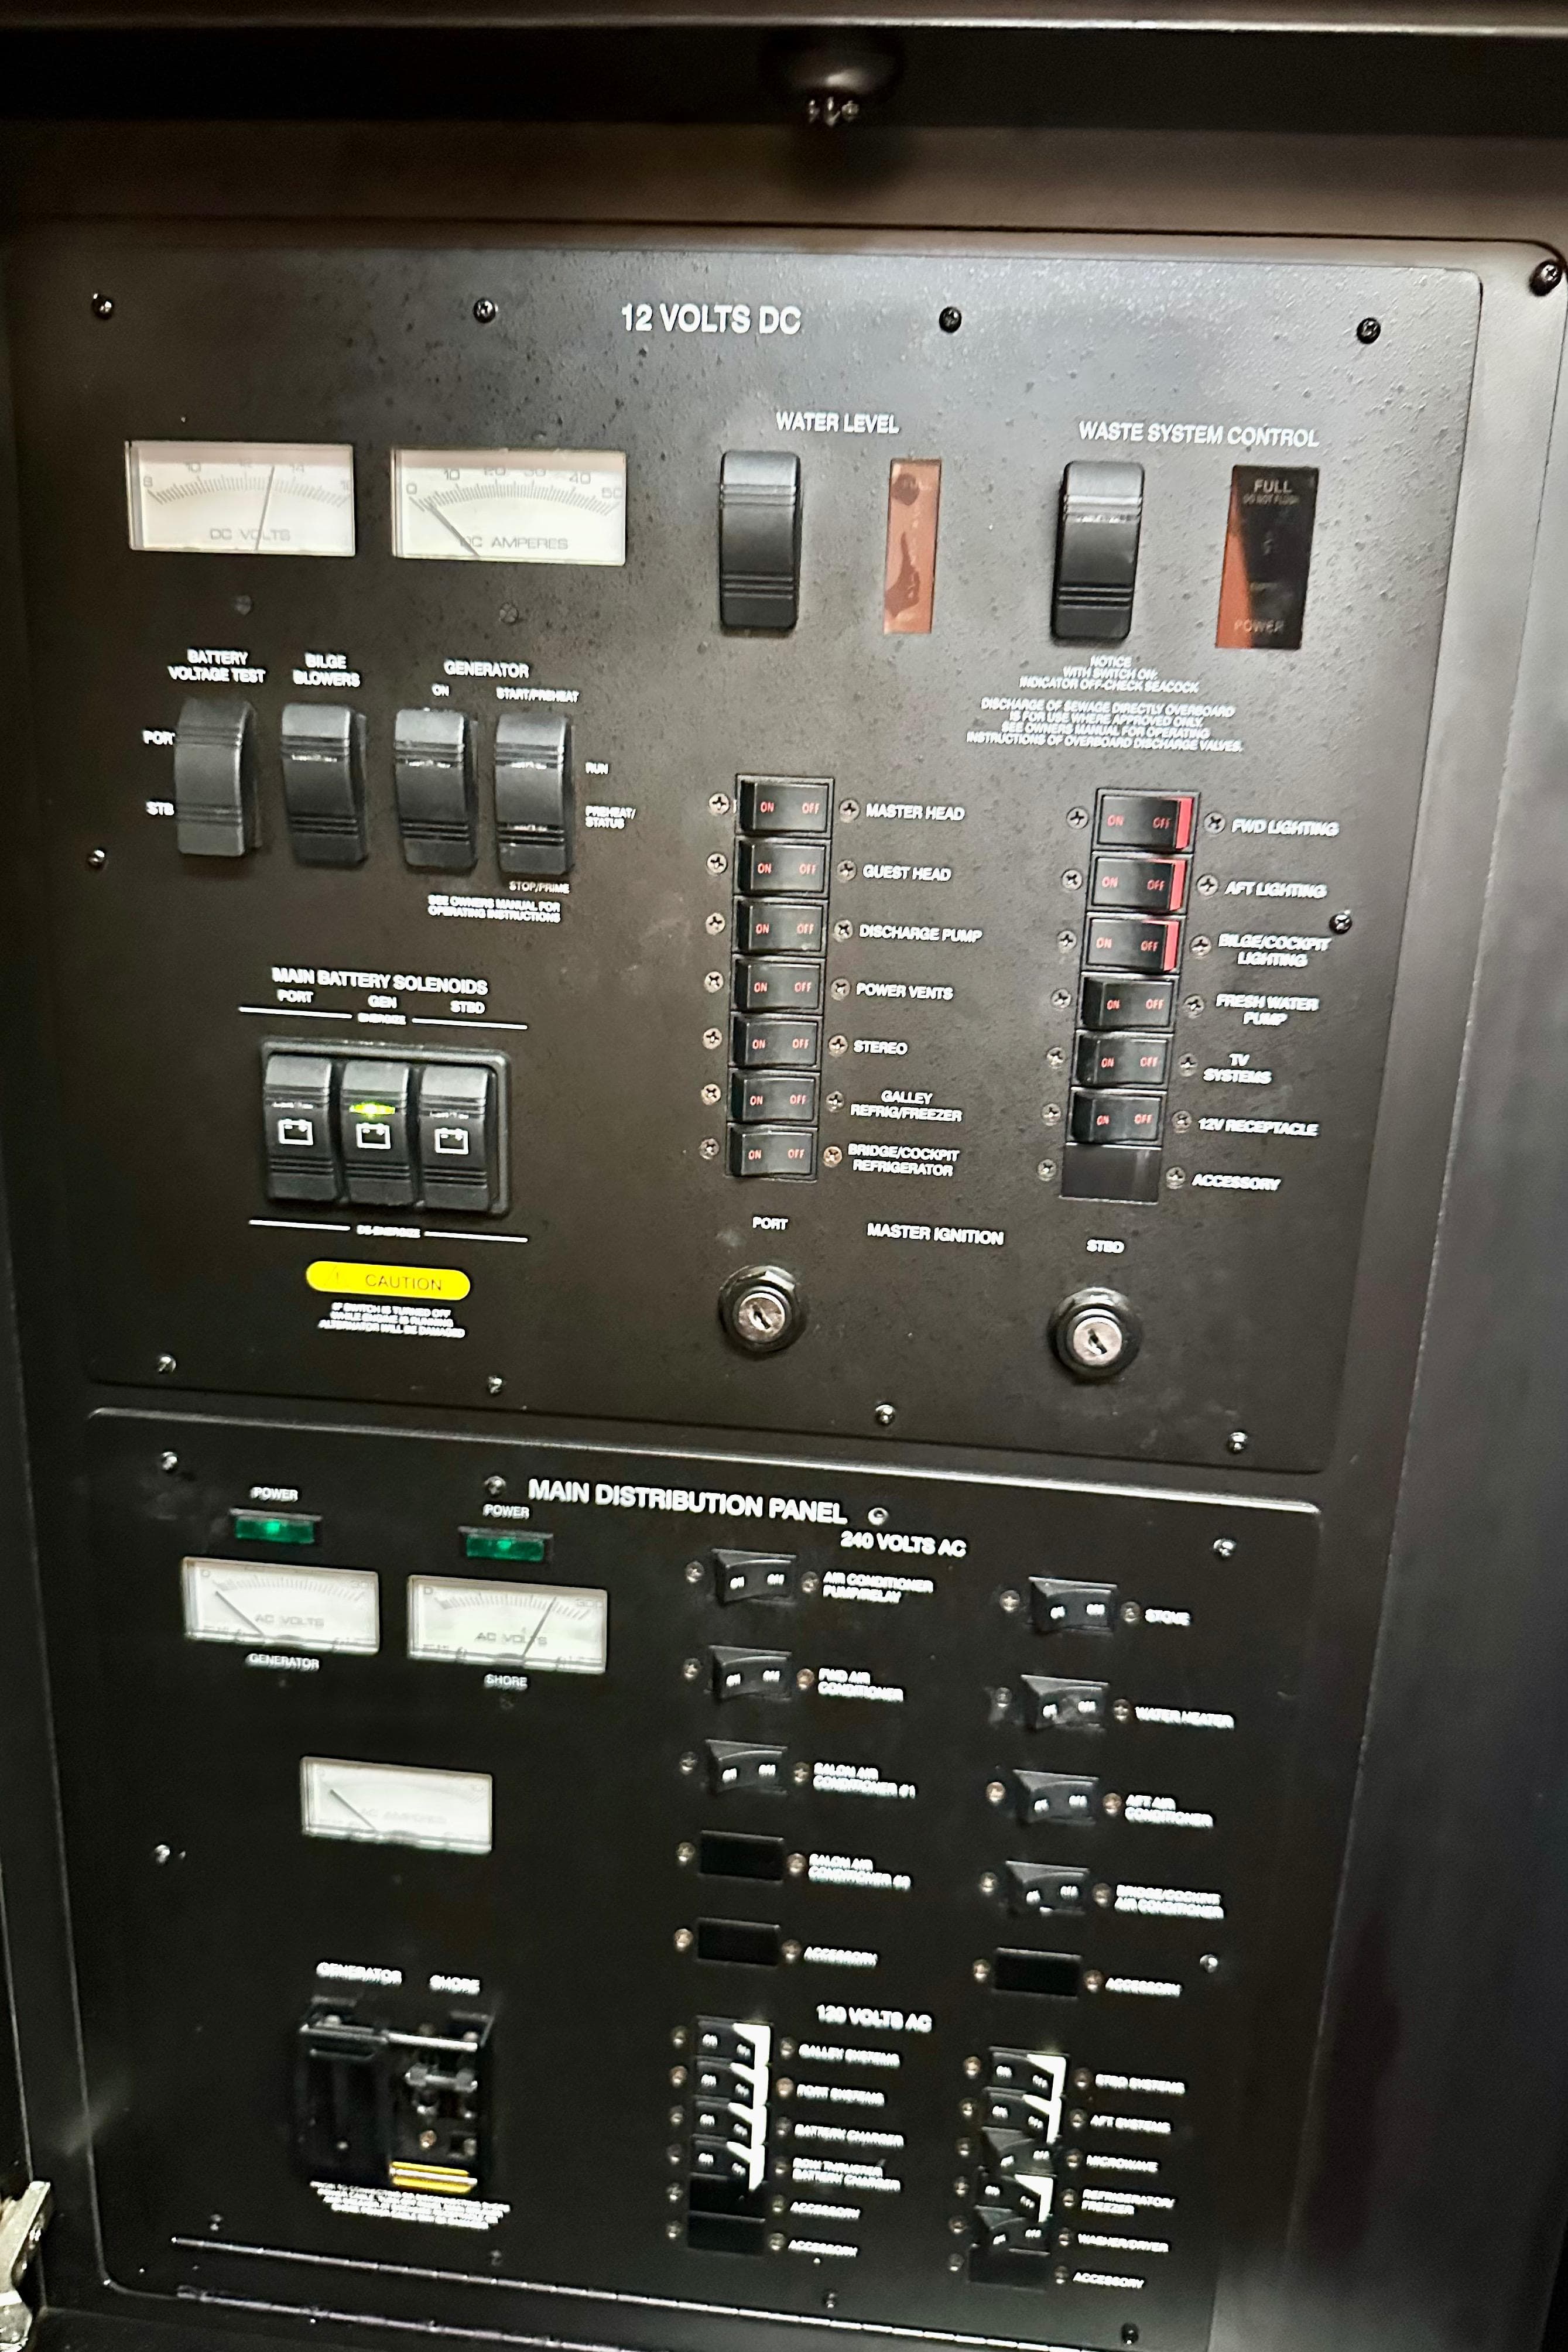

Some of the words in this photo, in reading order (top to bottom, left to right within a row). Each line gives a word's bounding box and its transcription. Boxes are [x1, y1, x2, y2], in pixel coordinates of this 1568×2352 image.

[621, 303, 653, 331] 12
[660, 304, 751, 333] VOLTS
[759, 306, 800, 334] DC
[776, 411, 838, 432] WATER
[844, 413, 900, 434] LEVEL
[1079, 421, 1144, 441] WASTE
[1147, 423, 1222, 445] SYSTEM
[1227, 426, 1320, 448] CONTROL
[1254, 479, 1293, 494] FULL
[210, 529, 232, 540] DC
[240, 530, 290, 540] VOLTS
[492, 537, 569, 549] AMPERES
[1234, 619, 1284, 634] POWER
[187, 649, 248, 665] BATTERY
[305, 653, 346, 669] BILGE
[1090, 655, 1132, 667] NOTICE
[168, 666, 230, 682] VOLTAGE
[232, 668, 265, 683] TEST
[444, 660, 529, 679] GENERATOR
[1063, 666, 1091, 678] WITH
[1093, 668, 1135, 679] SWITCH
[293, 670, 360, 687] BLOWERS
[1019, 676, 1077, 689] INDICATOR
[432, 684, 450, 697] ON
[496, 687, 579, 703] START/PREHEAT
[981, 698, 1045, 711] DISCHARGE
[1046, 700, 1062, 711] OF
[1063, 701, 1111, 713] SEWAGE
[1112, 703, 1163, 715] DIRECTLY
[1165, 706, 1235, 717] OVERBOARD
[1009, 711, 1021, 721] IS
[1022, 711, 1045, 723] FOR
[1046, 713, 1070, 724] USE
[1071, 714, 1111, 725] WHERE
[1112, 714, 1171, 727] APPROVED
[1001, 722, 1023, 733] SEE
[1074, 725, 1119, 737] MANUAL
[1121, 727, 1144, 737] FOR
[1146, 727, 1210, 739] OPERATING
[966, 731, 1045, 745] INSTRUCTIONS
[1047, 735, 1062, 746] OF
[1064, 736, 1131, 748] OVERBOARD
[1133, 738, 1198, 751] DISCHARGE
[586, 762, 608, 775] RUN
[761, 802, 774, 813] ON
[802, 803, 819, 814] OFF
[866, 804, 923, 820] MASTER
[925, 806, 965, 821] HEAD
[586, 817, 625, 829] STATUS
[1107, 815, 1124, 826] ON
[1153, 817, 1171, 829] OFF
[1231, 820, 1266, 834] FWD
[1268, 821, 1340, 837] LIGHTING
[758, 863, 772, 874] ON
[799, 864, 816, 875] OFF
[862, 864, 910, 879] GUEST
[912, 867, 951, 881] HEAD
[509, 881, 570, 894] STOP/PRIME
[1102, 877, 1118, 888] ON
[1147, 879, 1166, 891] OFF
[1224, 881, 1255, 896] AFT
[1256, 882, 1328, 899] LIGHTING
[755, 923, 769, 934] ON
[797, 924, 814, 934] OFF
[860, 924, 939, 941] DISCHARGE
[942, 928, 983, 943] PUMP
[1096, 937, 1112, 949] ON
[1141, 940, 1158, 951] OFF
[1218, 934, 1333, 951] BILGE/COCKPIT
[1238, 951, 1308, 968] LIGHTING
[272, 967, 315, 984] MAIN
[317, 970, 391, 988] BATTERY
[393, 974, 488, 995] SOLENOIDS
[754, 982, 767, 993] ON
[795, 982, 811, 993] OFF
[278, 990, 313, 1004] PORT
[857, 982, 907, 998] POWER
[909, 985, 953, 1000] VENTS
[368, 995, 397, 1009] GEN
[450, 1001, 485, 1014] STBD
[1107, 999, 1120, 1010] ON
[1146, 999, 1165, 1010] OFF
[1216, 994, 1265, 1009] FRESH
[1266, 996, 1319, 1011] WATER
[1243, 1012, 1288, 1026] PUMP
[752, 1039, 765, 1049] ON
[792, 1039, 809, 1049] OFF
[854, 1040, 908, 1055] STEREO
[1101, 1057, 1114, 1068] ON
[1140, 1057, 1158, 1068] OFF
[1229, 1054, 1250, 1066] TV
[1203, 1069, 1272, 1084] SYSTEMS
[749, 1095, 763, 1105] ON
[790, 1094, 806, 1105] OFF
[881, 1090, 933, 1105] GALLEY
[851, 1104, 962, 1122] REFRIG/FREEZER
[1097, 1115, 1110, 1126] ON
[1134, 1114, 1153, 1125] OFF
[1199, 1118, 1224, 1131] 12V
[1226, 1119, 1319, 1137] RECEPTACLE
[748, 1149, 761, 1160] ON
[788, 1149, 804, 1159] OFF
[848, 1143, 960, 1162] BRIDGE/COCKPIT
[853, 1160, 953, 1177] REFRIGERATOR
[1192, 1174, 1281, 1191] ACCESSORY
[752, 1217, 789, 1231] PORT
[867, 1223, 930, 1241] MASTER
[934, 1226, 1004, 1246] IGNITION
[1086, 1239, 1125, 1255] STBD
[365, 1274, 441, 1291] CAUTION
[249, 1487, 299, 1502] POWER
[528, 1479, 589, 1503] MAIN
[595, 1483, 764, 1518] DISTRIBUTION
[769, 1497, 847, 1524] PANEL
[483, 1504, 530, 1519] POWER
[841, 1531, 874, 1549] 240
[877, 1533, 935, 1555] VOLTS
[938, 1539, 966, 1557] AC
[245, 1653, 320, 1672] GENERATOR
[485, 1674, 528, 1692] SHORE
[849, 2007, 903, 2031] VOLTS
[905, 2013, 932, 2033] AC
